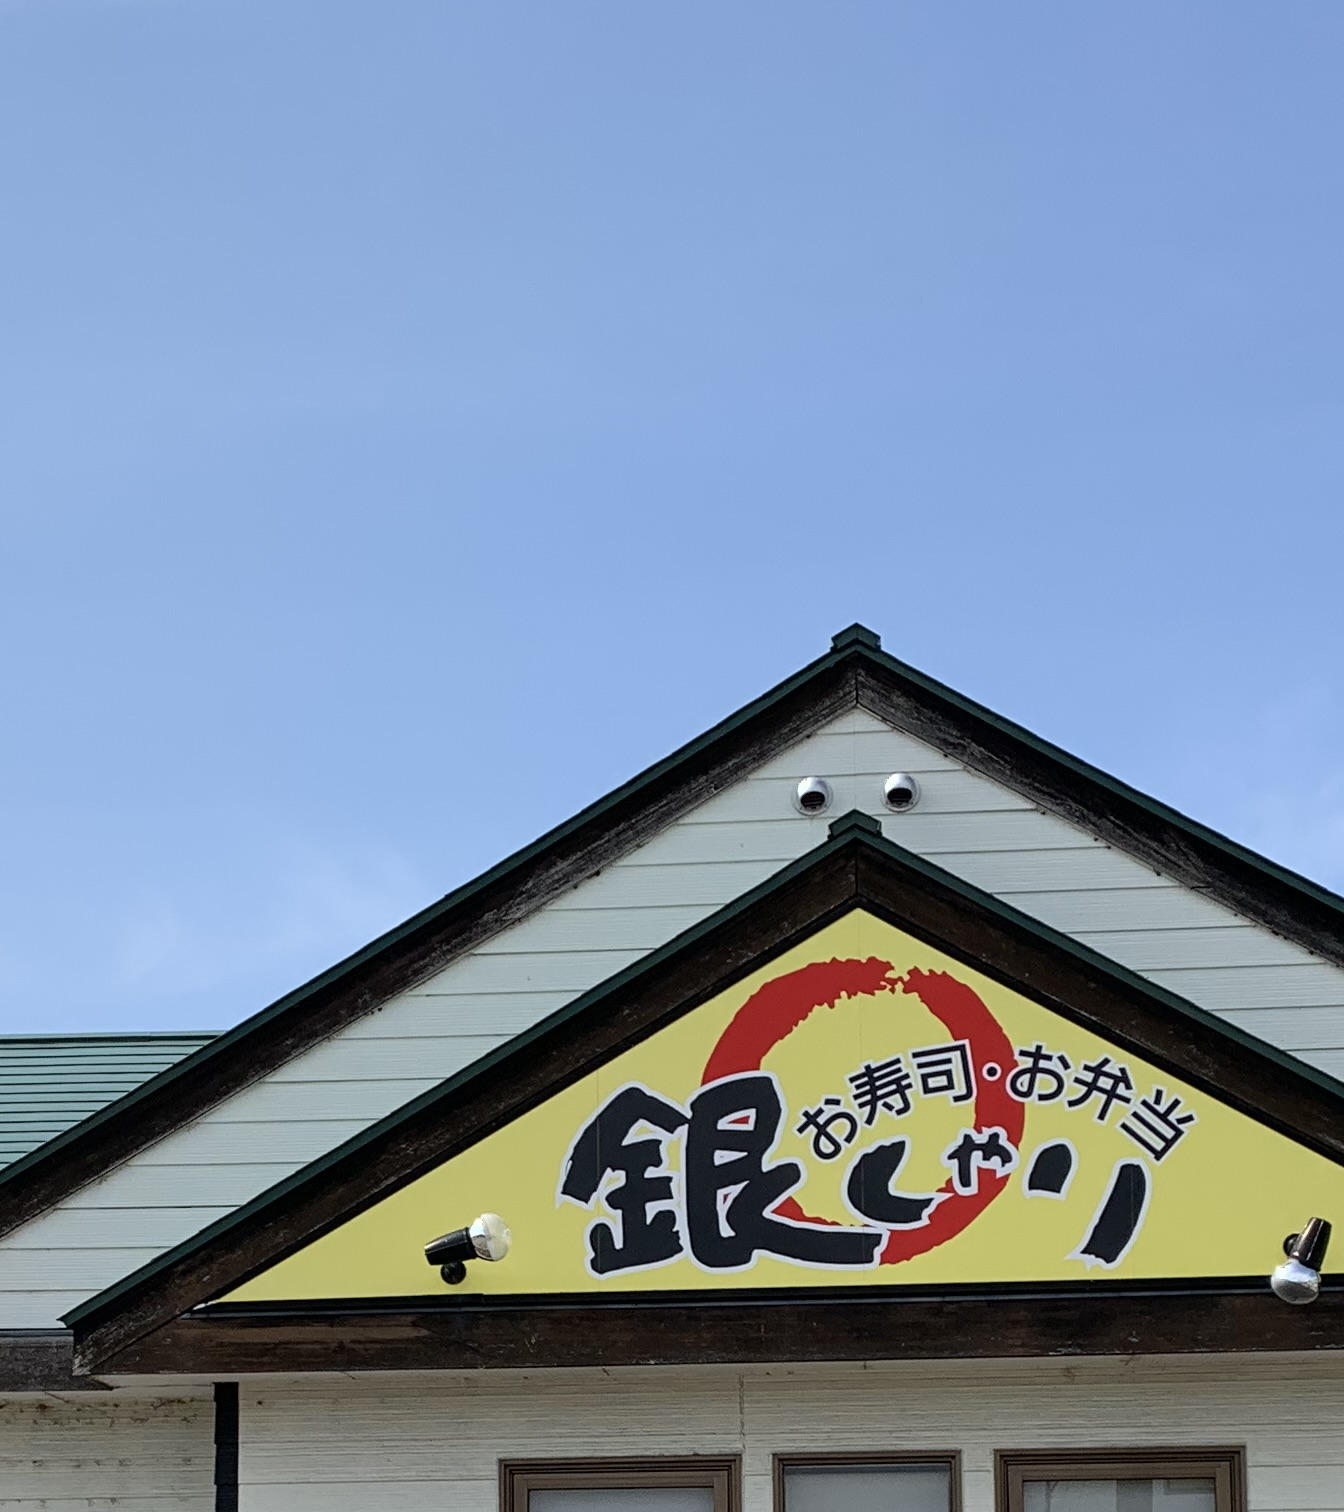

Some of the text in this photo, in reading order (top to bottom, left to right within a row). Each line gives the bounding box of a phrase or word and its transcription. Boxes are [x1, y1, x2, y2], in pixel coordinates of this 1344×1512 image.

[561, 1074, 1148, 1274] 銀しゃり
[796, 1040, 1197, 1161] お寿司・お弁当
